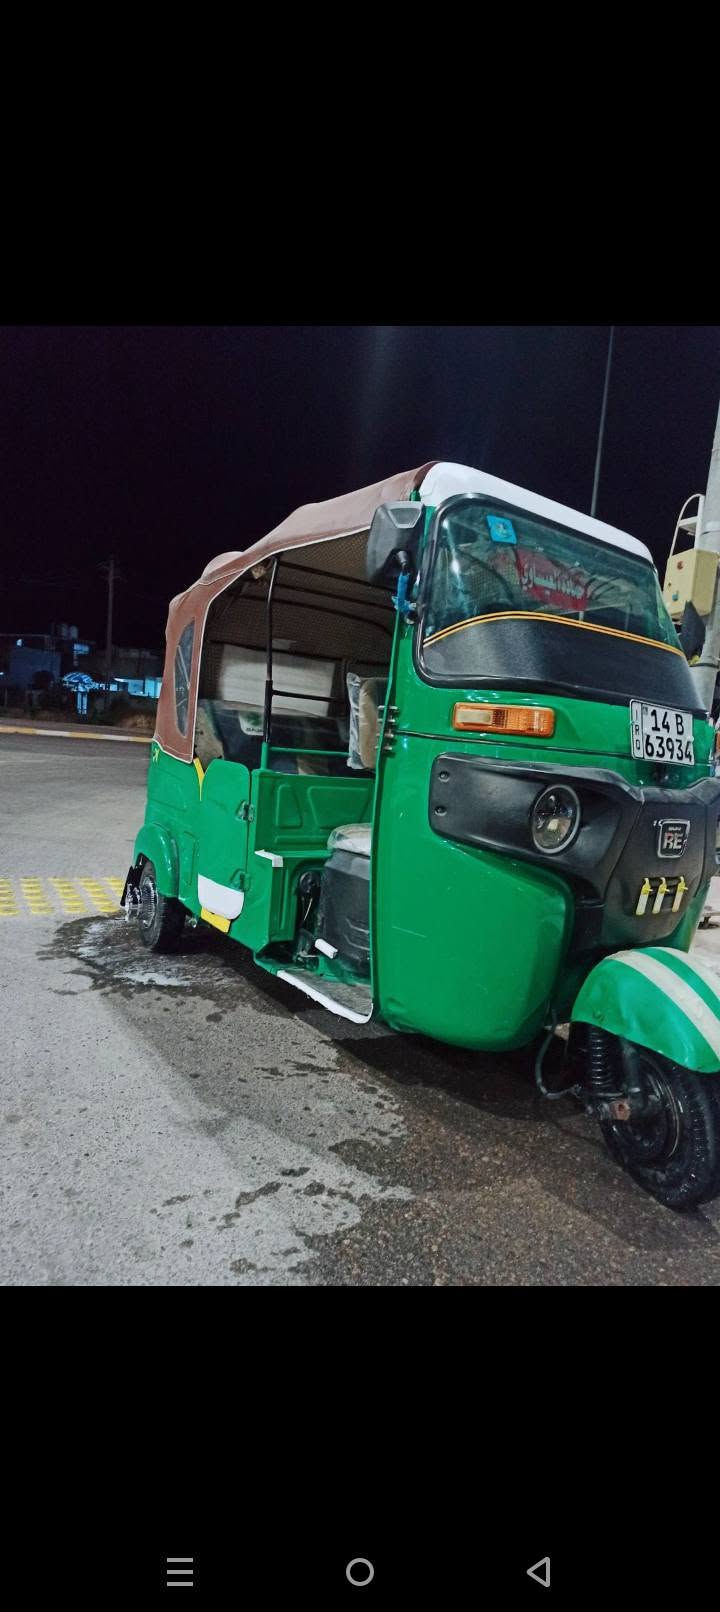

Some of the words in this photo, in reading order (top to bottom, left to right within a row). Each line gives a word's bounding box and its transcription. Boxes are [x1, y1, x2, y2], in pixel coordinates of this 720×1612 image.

[651, 709, 670, 733] 14
[675, 713, 684, 735] B
[645, 734, 692, 762] 63934
[663, 832, 684, 849] RE
